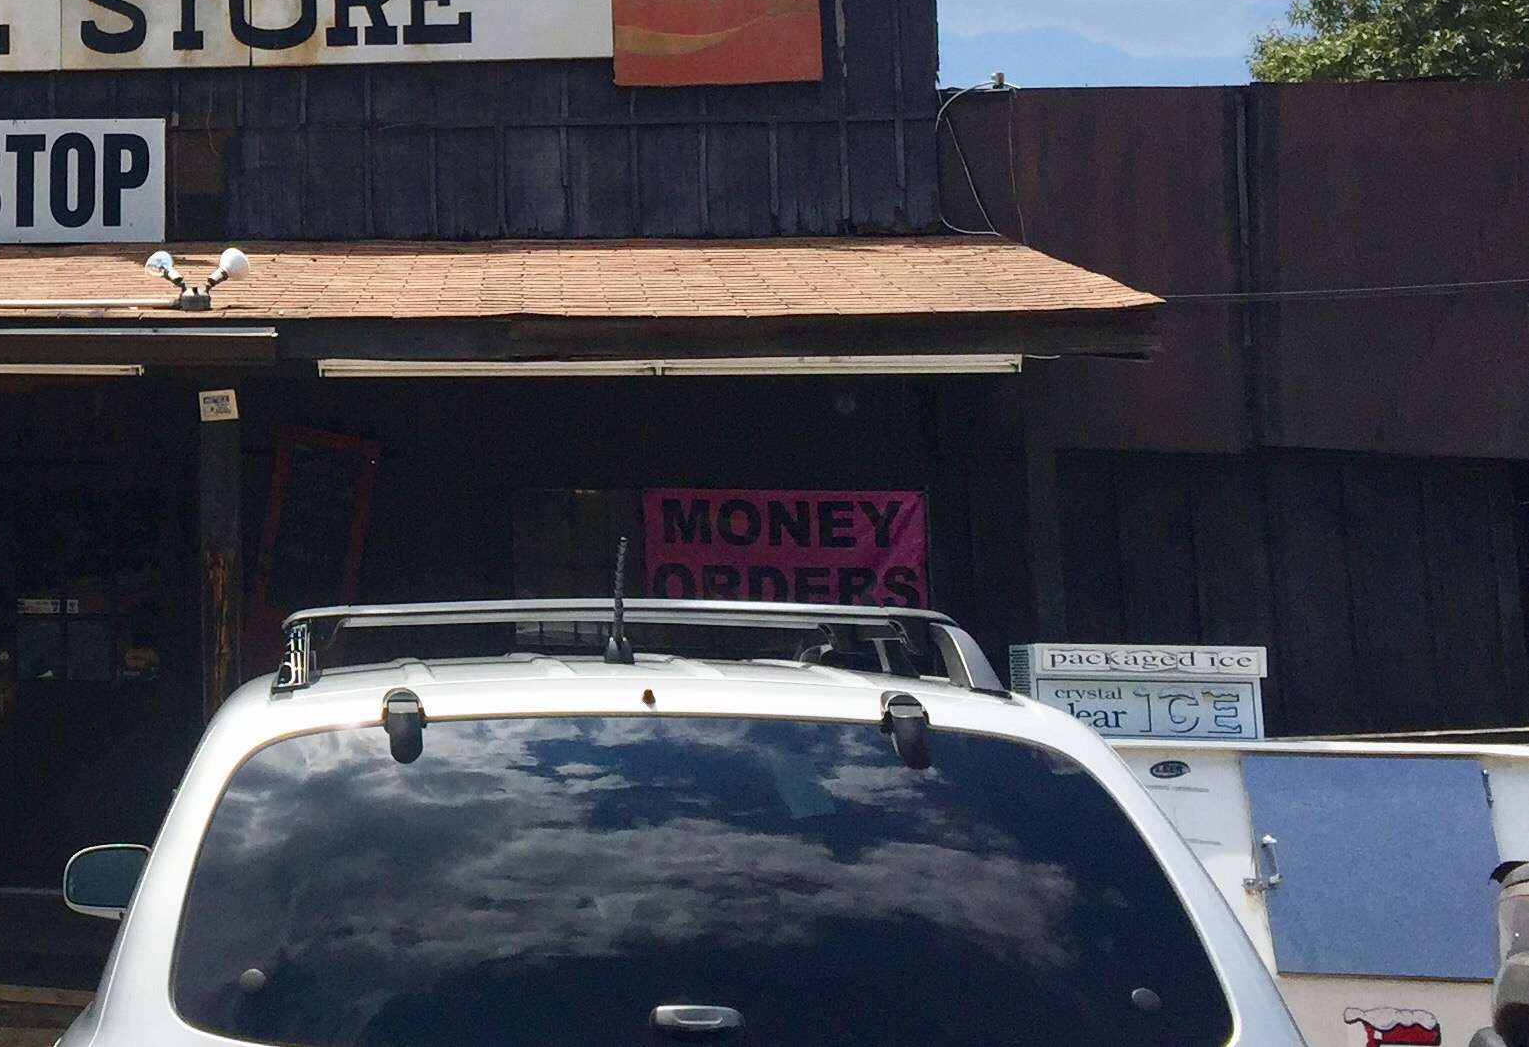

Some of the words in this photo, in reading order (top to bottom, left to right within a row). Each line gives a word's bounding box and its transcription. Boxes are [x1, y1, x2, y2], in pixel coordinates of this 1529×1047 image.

[661, 498, 904, 548] MONEY
[652, 562, 921, 606] ORDERS
[1049, 650, 1197, 670] packaged
[1209, 651, 1253, 669] ice
[1053, 686, 1123, 701] crystal
[1132, 688, 1243, 735] ICE
[1066, 702, 1128, 730] lear
